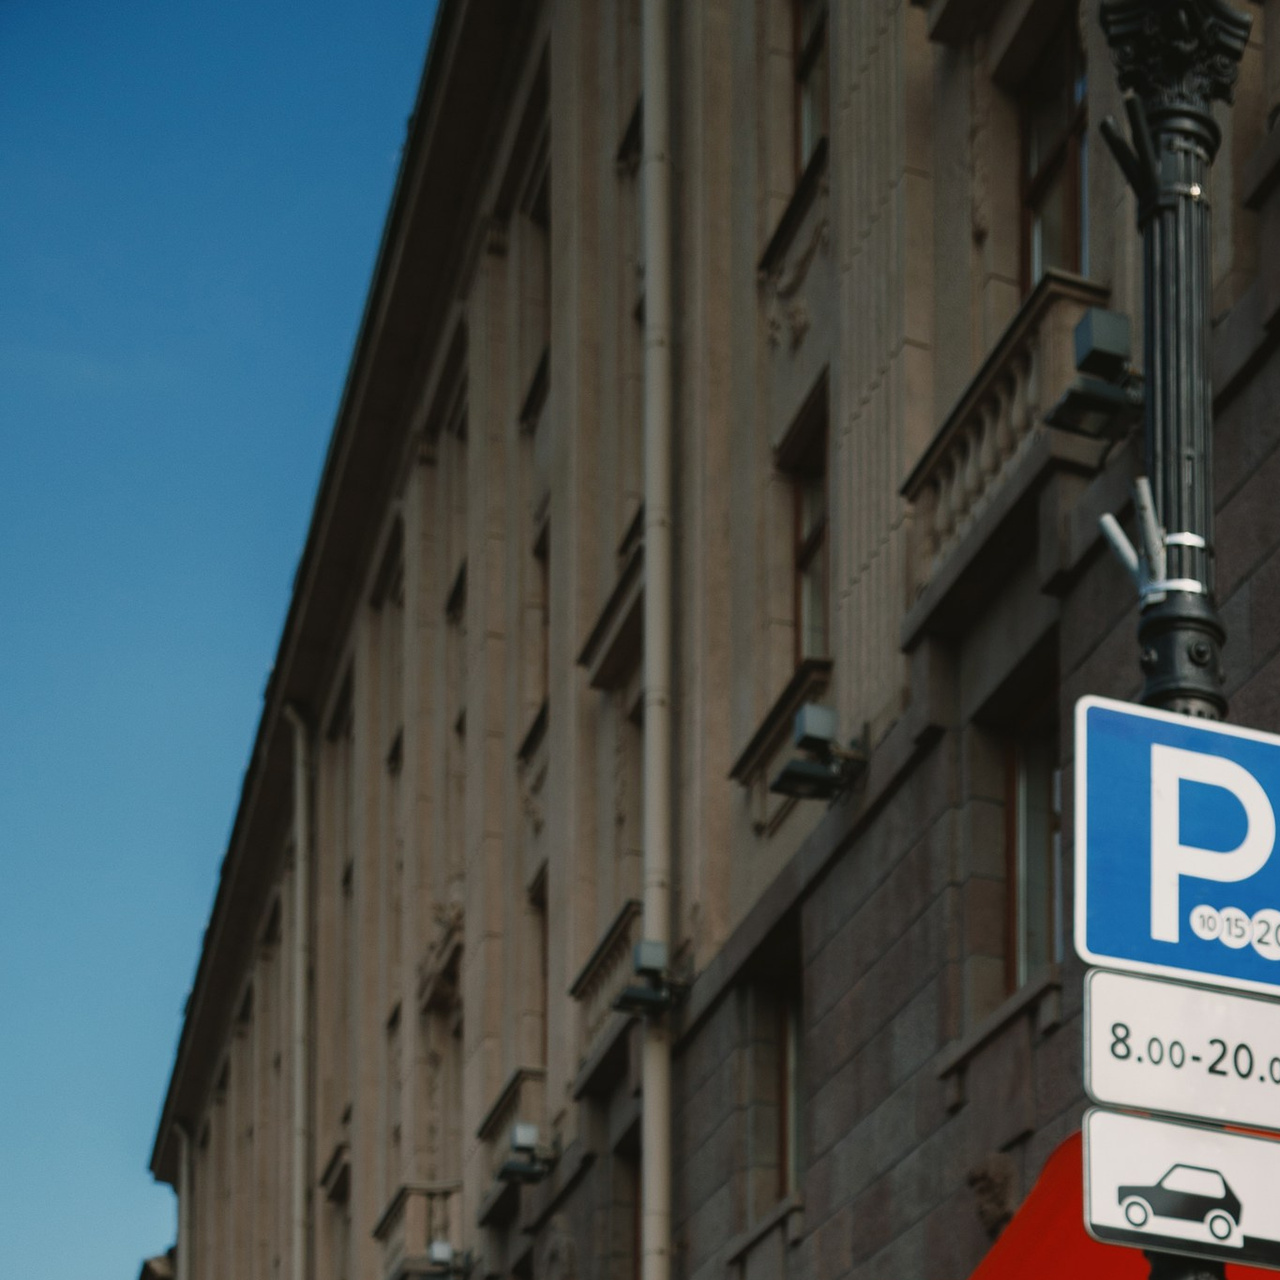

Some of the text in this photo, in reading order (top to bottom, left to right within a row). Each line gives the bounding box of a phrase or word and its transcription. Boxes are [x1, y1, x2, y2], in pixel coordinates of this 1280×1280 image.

[1150, 743, 1276, 944] P
[1199, 914, 1217, 932] 10
[1225, 917, 1246, 939] 15
